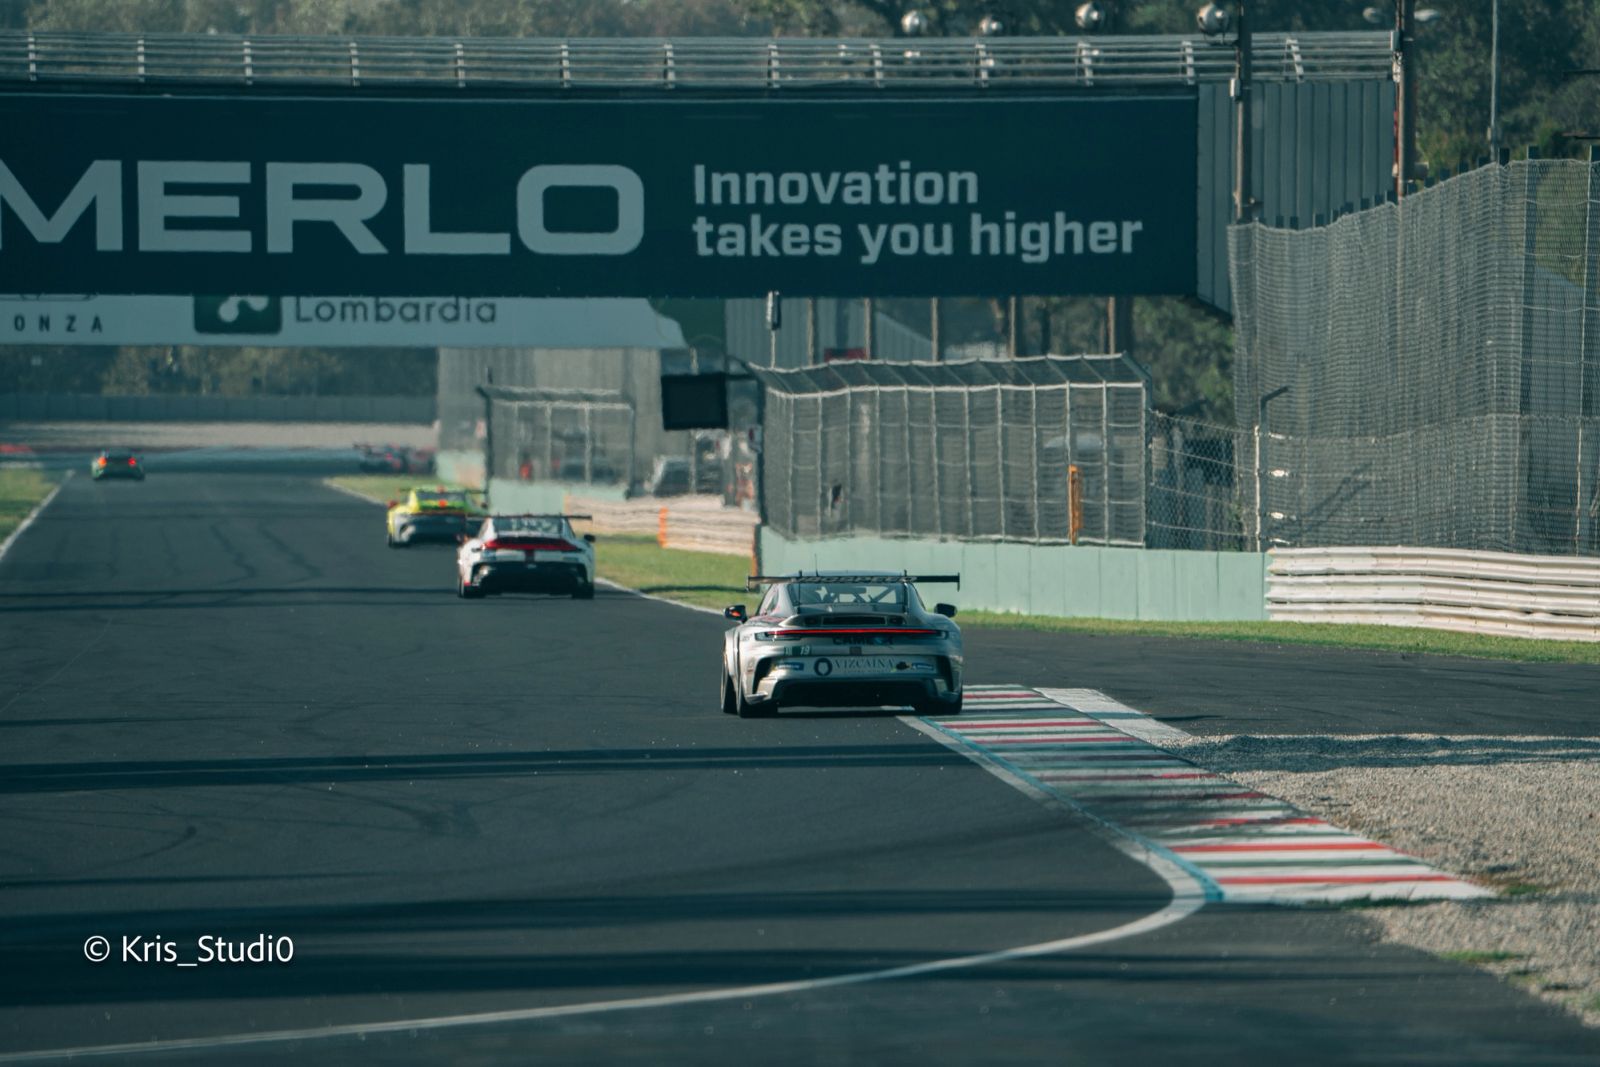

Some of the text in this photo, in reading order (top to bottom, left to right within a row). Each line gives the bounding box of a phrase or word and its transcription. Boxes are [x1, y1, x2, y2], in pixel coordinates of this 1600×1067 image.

[693, 160, 979, 205] Innovation
[0, 159, 645, 256] MERLO
[692, 211, 1143, 264] takes you higher
[295, 296, 497, 323] Lombardia
